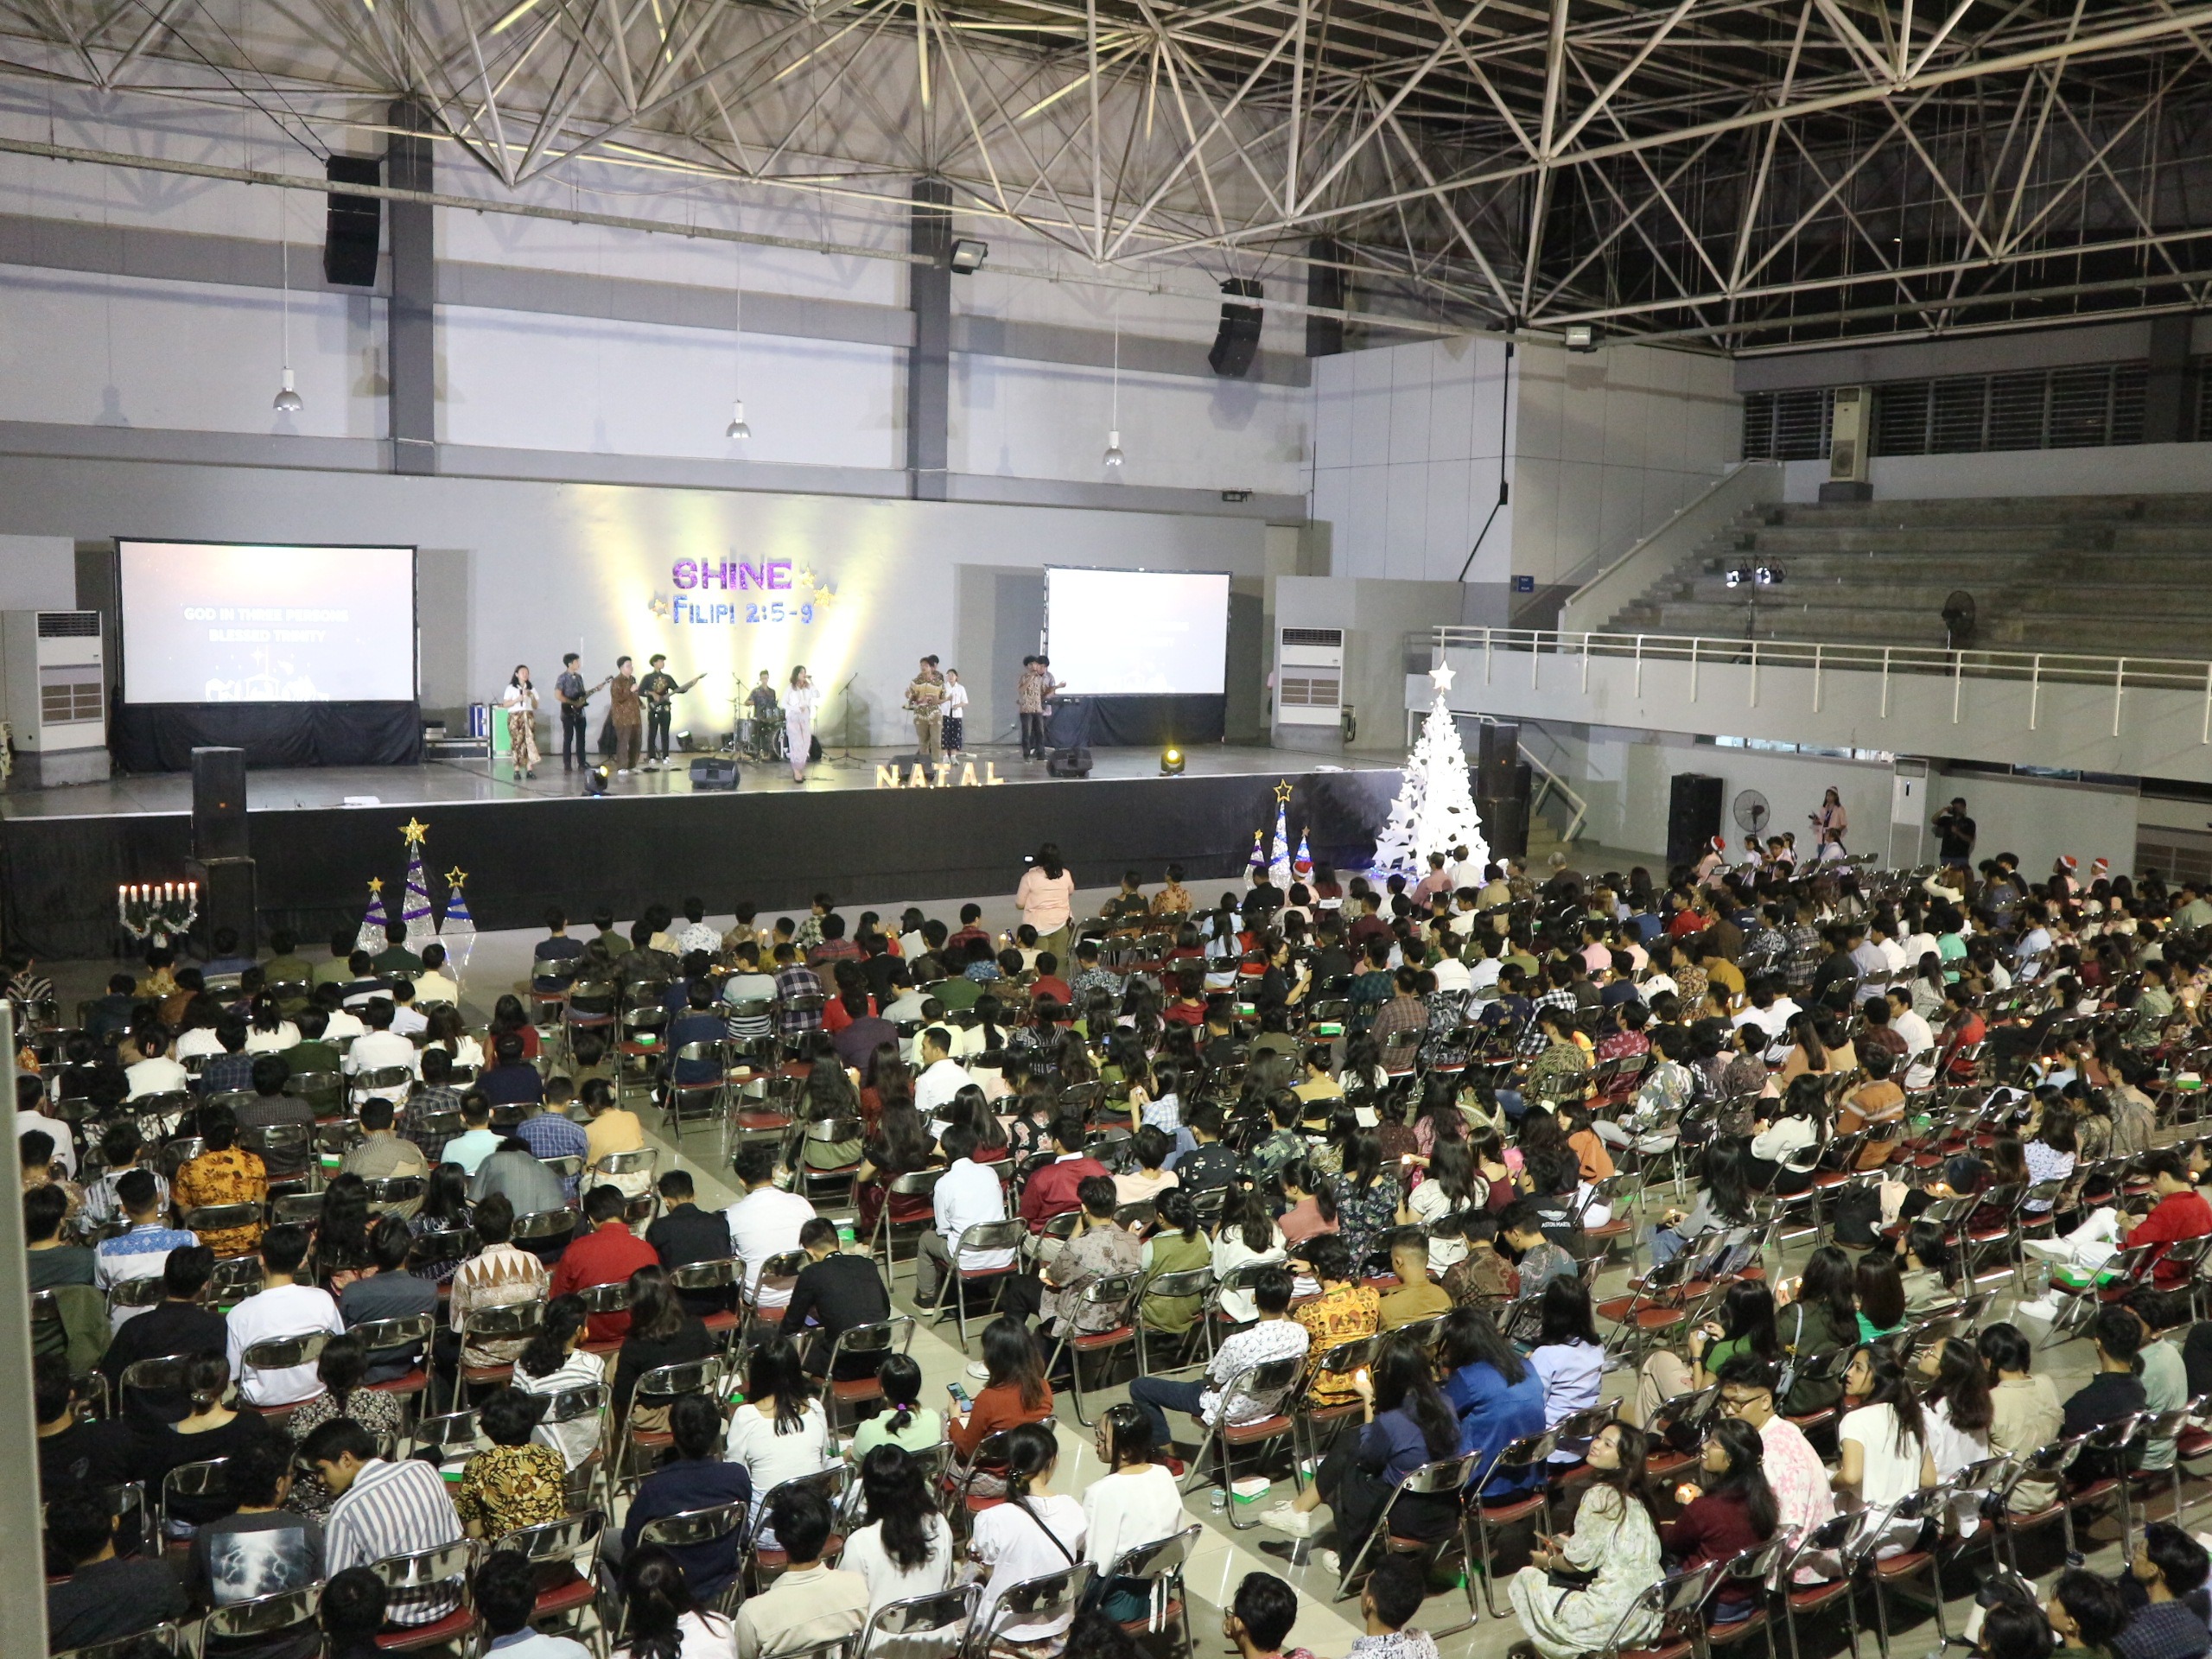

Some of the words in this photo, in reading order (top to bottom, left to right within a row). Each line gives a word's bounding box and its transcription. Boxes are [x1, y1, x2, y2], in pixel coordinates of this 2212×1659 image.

[672, 561, 792, 590] SHINE
[183, 607, 217, 621] GOD
[219, 607, 235, 621] IN
[237, 608, 283, 622] THREE
[285, 609, 350, 622] PERSONS
[672, 594, 736, 624] FILIPI
[745, 602, 814, 624] 2:5-9
[208, 629, 271, 643] BLESSED
[272, 630, 327, 643] TRINITY
[874, 761, 1004, 788] NATAL
